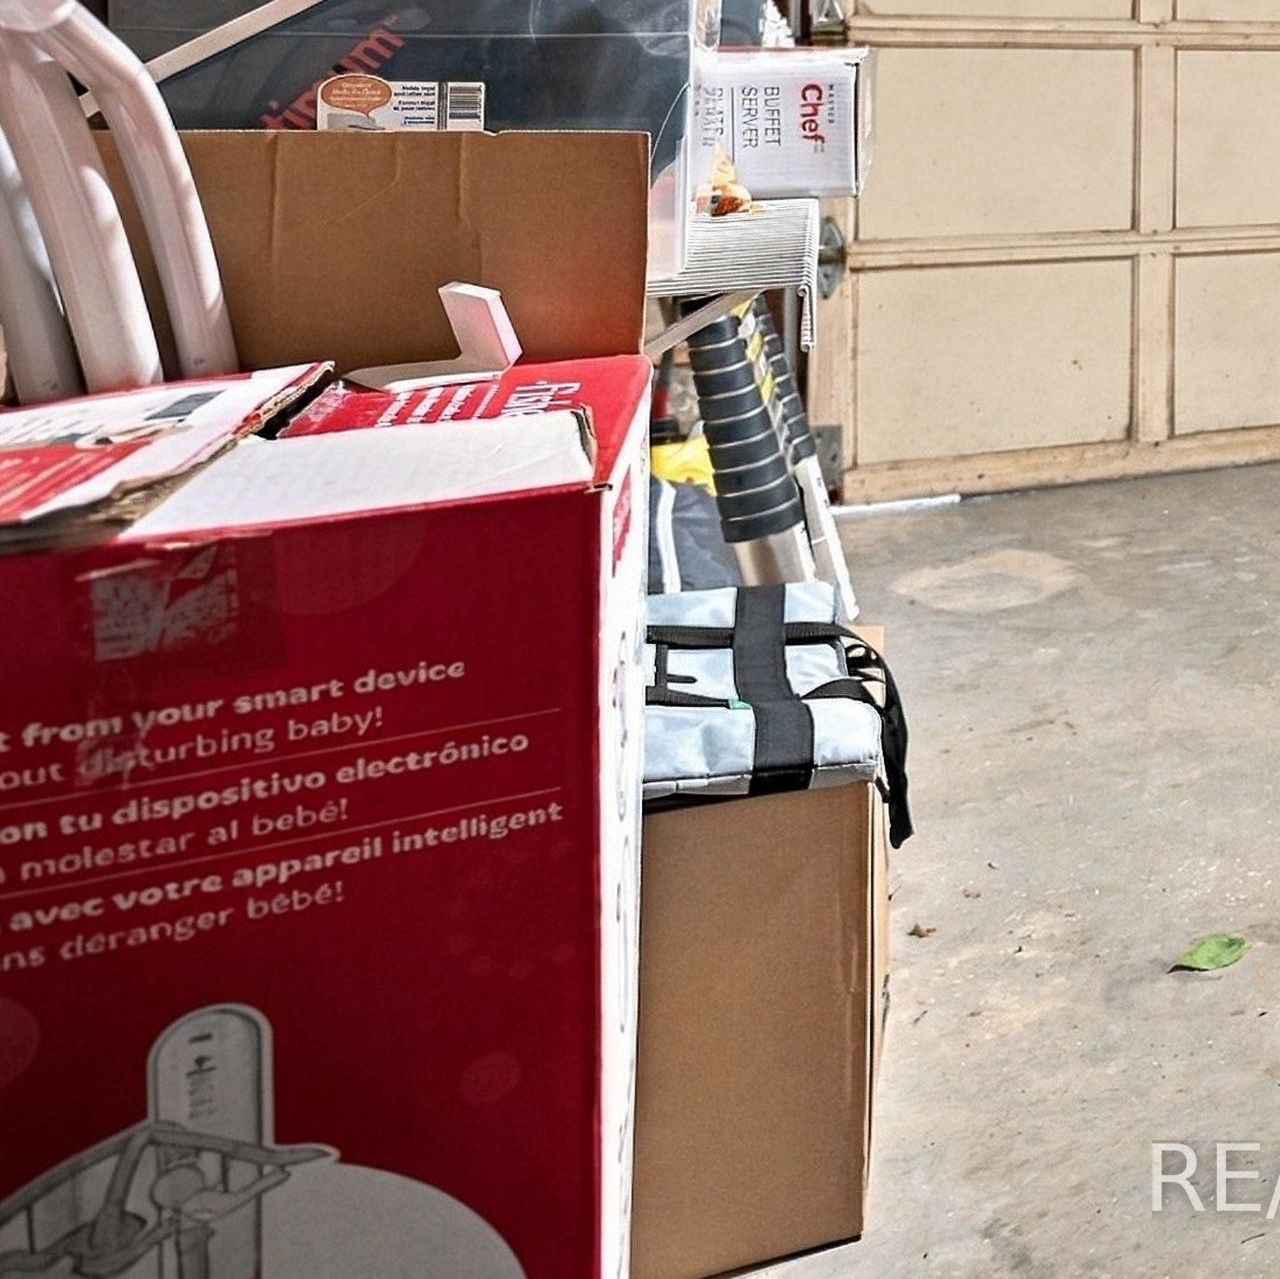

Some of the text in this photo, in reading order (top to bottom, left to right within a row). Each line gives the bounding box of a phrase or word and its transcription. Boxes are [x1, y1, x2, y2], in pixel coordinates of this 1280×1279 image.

[741, 86, 758, 149] SERVER
[764, 86, 781, 147] BUFFET
[801, 83, 826, 145] Chef
[22, 722, 122, 748] from
[131, 699, 223, 739] your
[232, 678, 344, 714] smart
[354, 661, 465, 694] device
[287, 706, 383, 741] baby!
[59, 813, 102, 835] tu
[111, 771, 326, 826] dispositivo
[336, 734, 529, 784] electrónico
[10, 801, 563, 932] avec votre appareil intelligent
[20, 798, 348, 881] molestar al bebé!
[247, 881, 344, 919] bébé!
